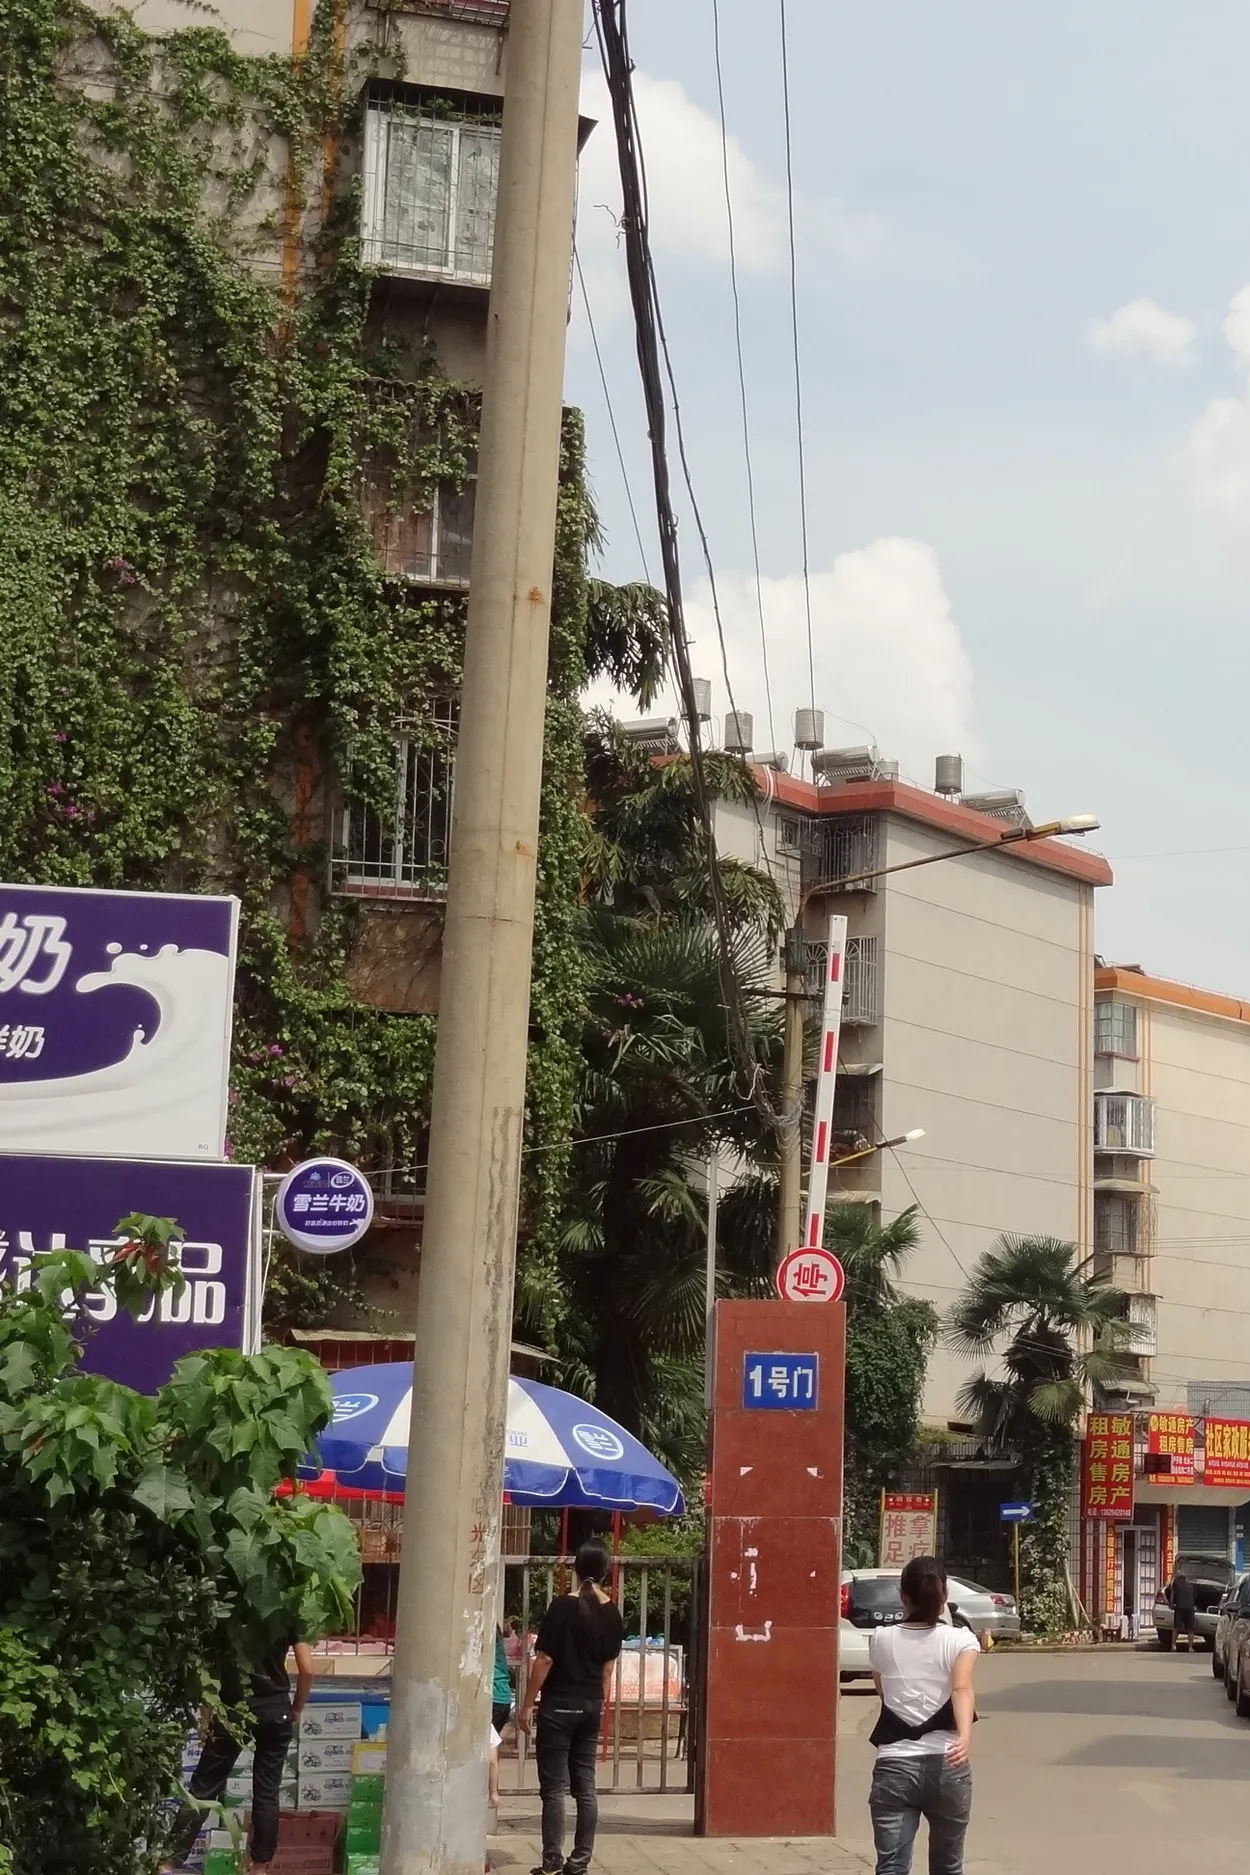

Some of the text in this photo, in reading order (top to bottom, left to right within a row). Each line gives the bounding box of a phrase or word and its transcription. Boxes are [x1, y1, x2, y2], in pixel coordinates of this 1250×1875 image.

[293, 1193, 366, 1213] 雪兰牛奶
[792, 1261, 828, 1298] 停
[749, 1364, 813, 1399] 1号门
[1160, 1415, 1194, 1435] 敏通房产
[1159, 1436, 1194, 1454] 租房售房
[1088, 1416, 1109, 1505] 租房售房
[1110, 1416, 1132, 1505] 敏通房产
[885, 1513, 931, 1538] 推拿
